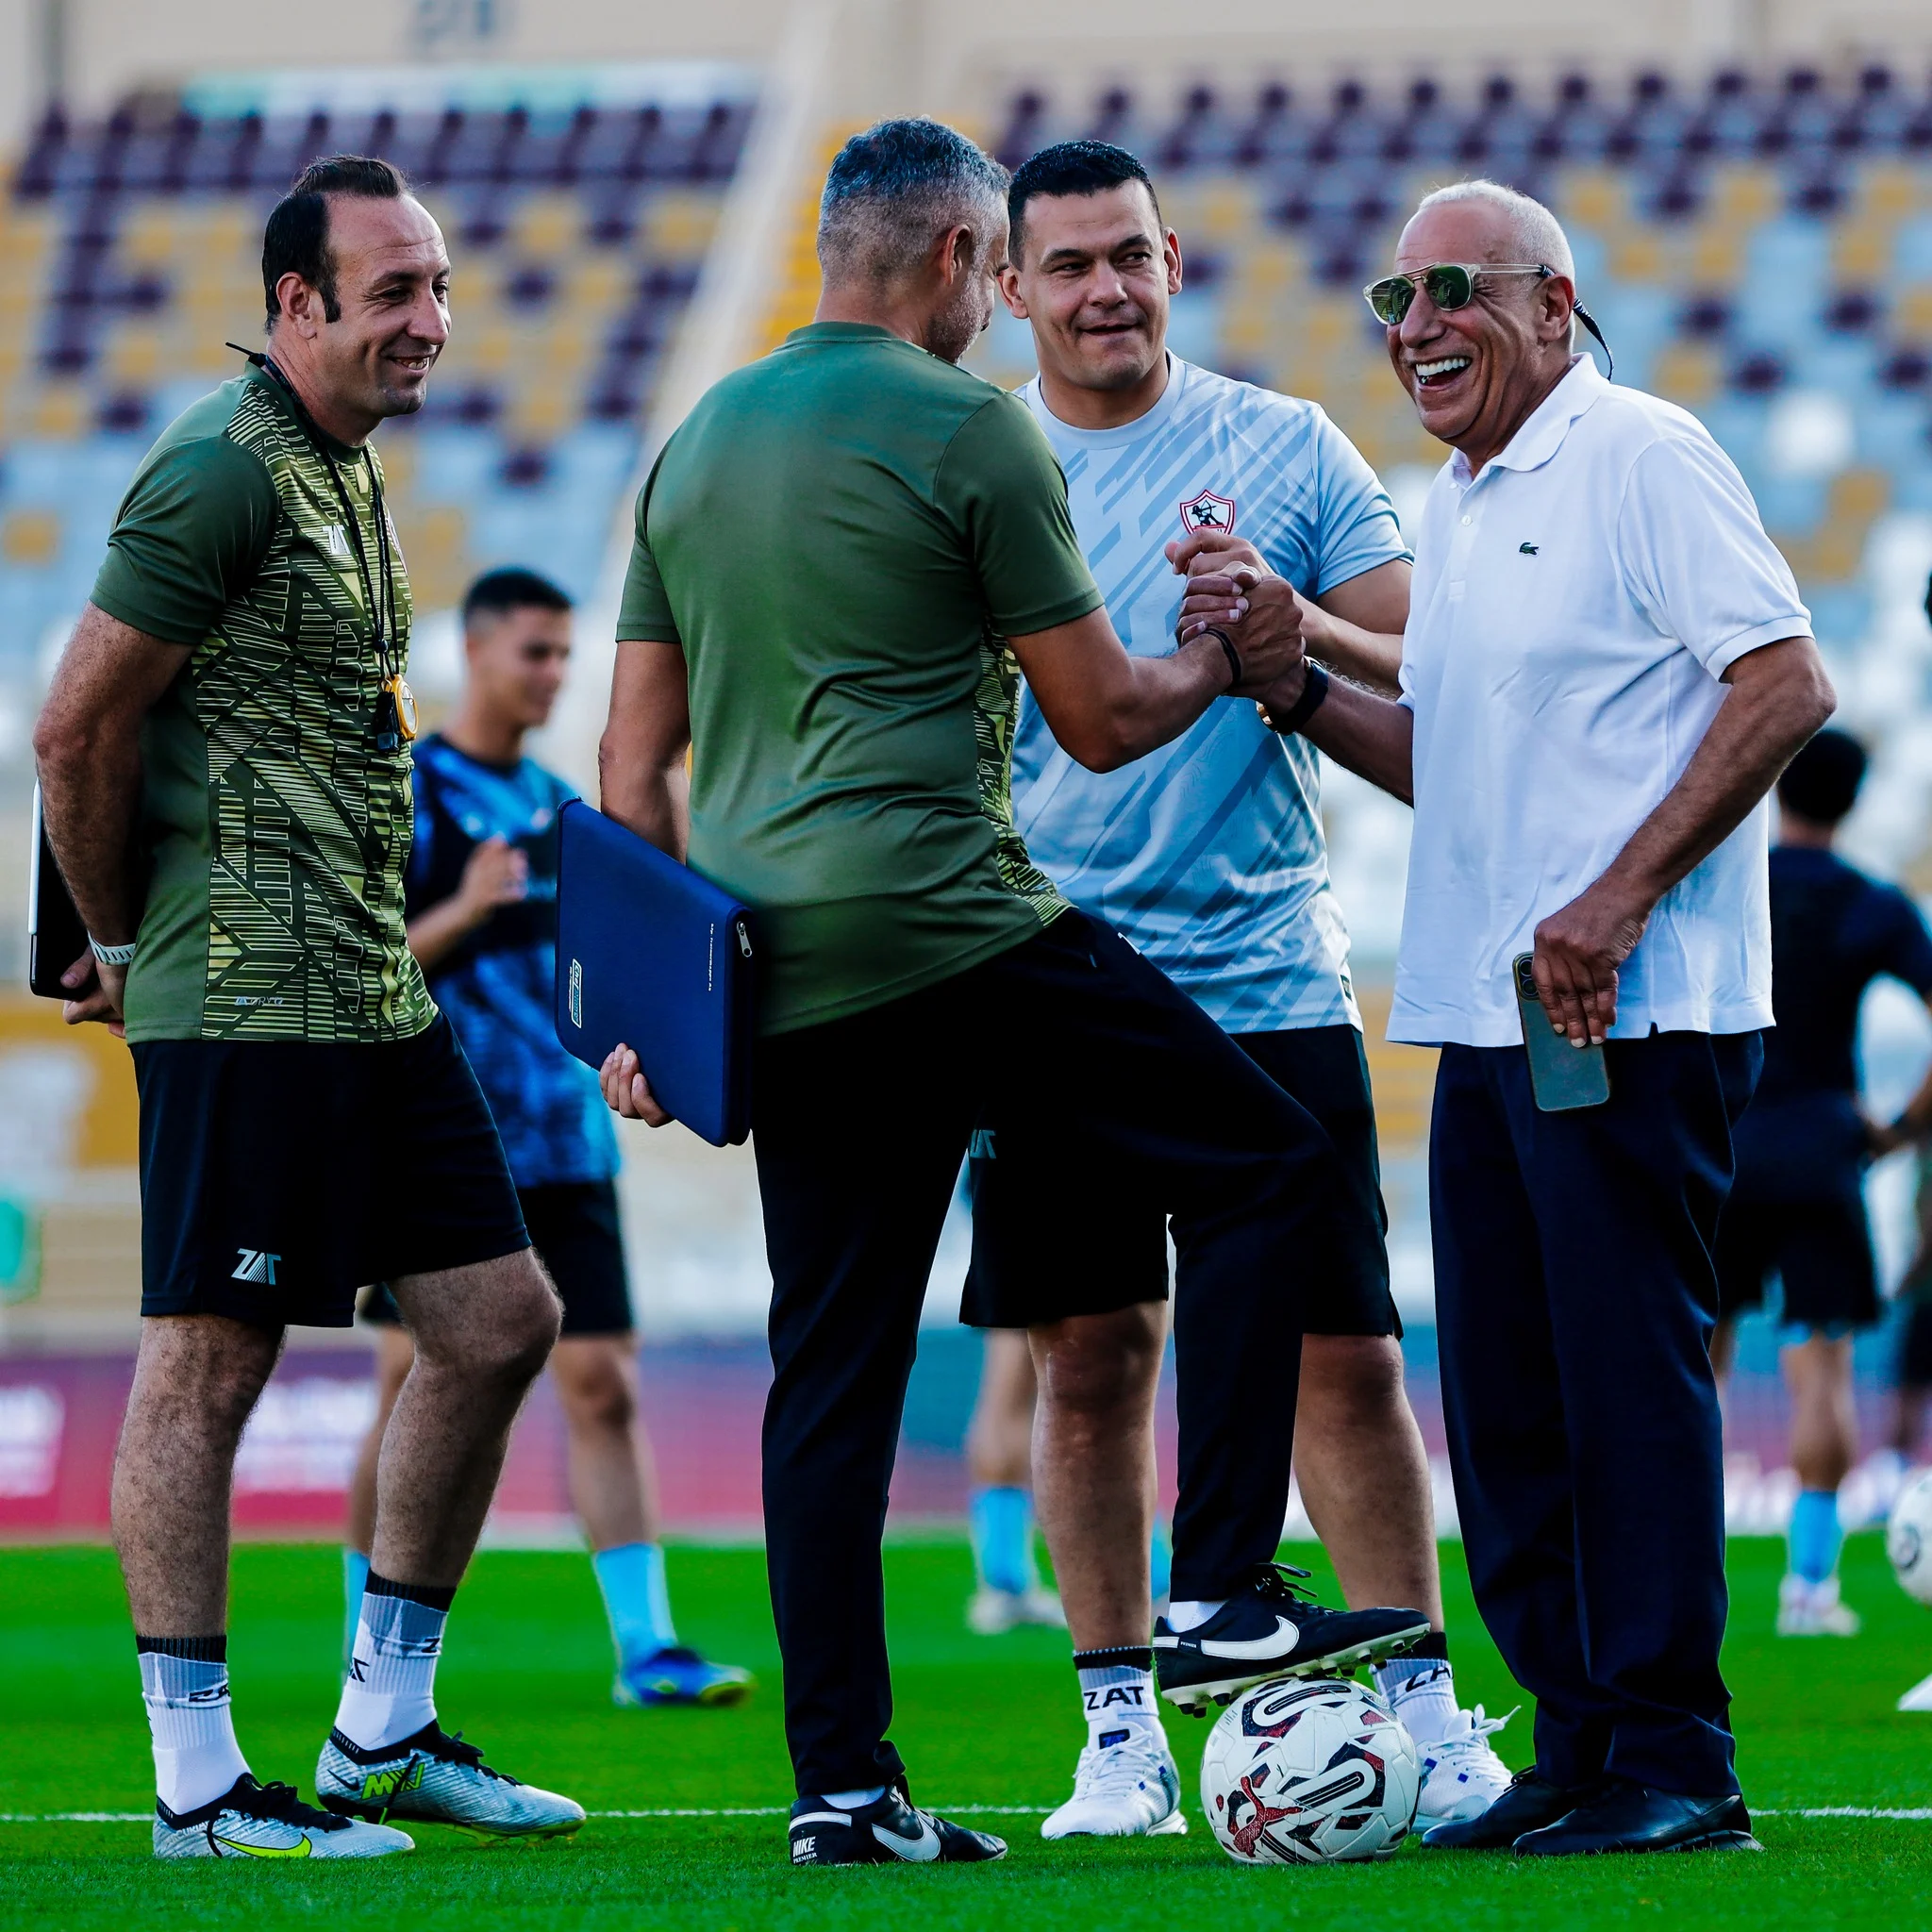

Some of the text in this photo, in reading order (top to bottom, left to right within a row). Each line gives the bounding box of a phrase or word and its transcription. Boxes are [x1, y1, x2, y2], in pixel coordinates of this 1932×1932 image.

[231, 1248, 282, 1286] ZAT
[1083, 1686, 1144, 1710] ZAT
[792, 1836, 816, 1857] NIKE
